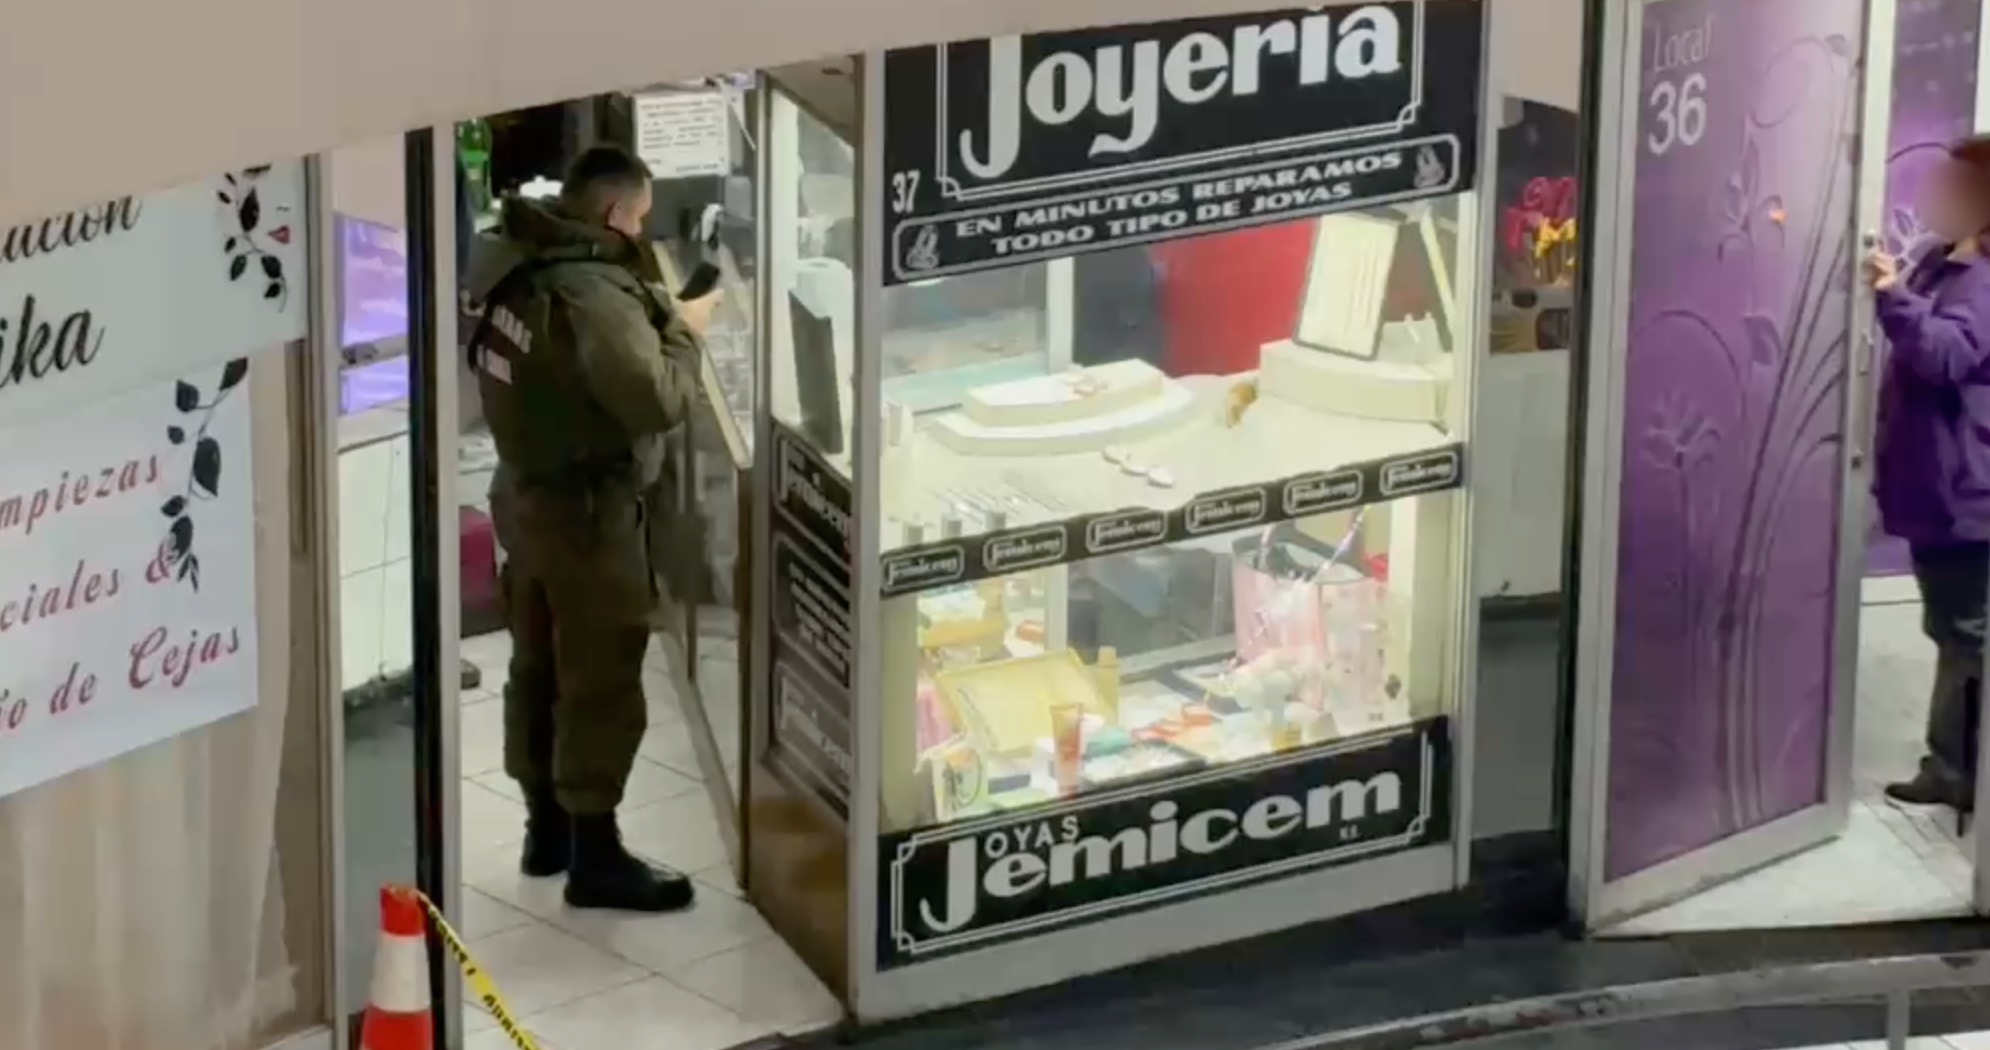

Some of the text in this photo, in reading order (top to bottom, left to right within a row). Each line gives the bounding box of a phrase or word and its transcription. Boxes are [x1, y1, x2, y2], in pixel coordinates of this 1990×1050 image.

[1654, 13, 1712, 73] Local
[1649, 72, 1707, 156] 36
[892, 170, 921, 213] 37
[956, 152, 1403, 237] EN MINUTOS REPARAMOS
[991, 182, 1352, 255] TODO TIPO DE JOYAS
[145, 538, 176, 584] &
[49, 661, 97, 715] de
[128, 626, 240, 690] Cejas
[919, 770, 1401, 933] Jemicem
